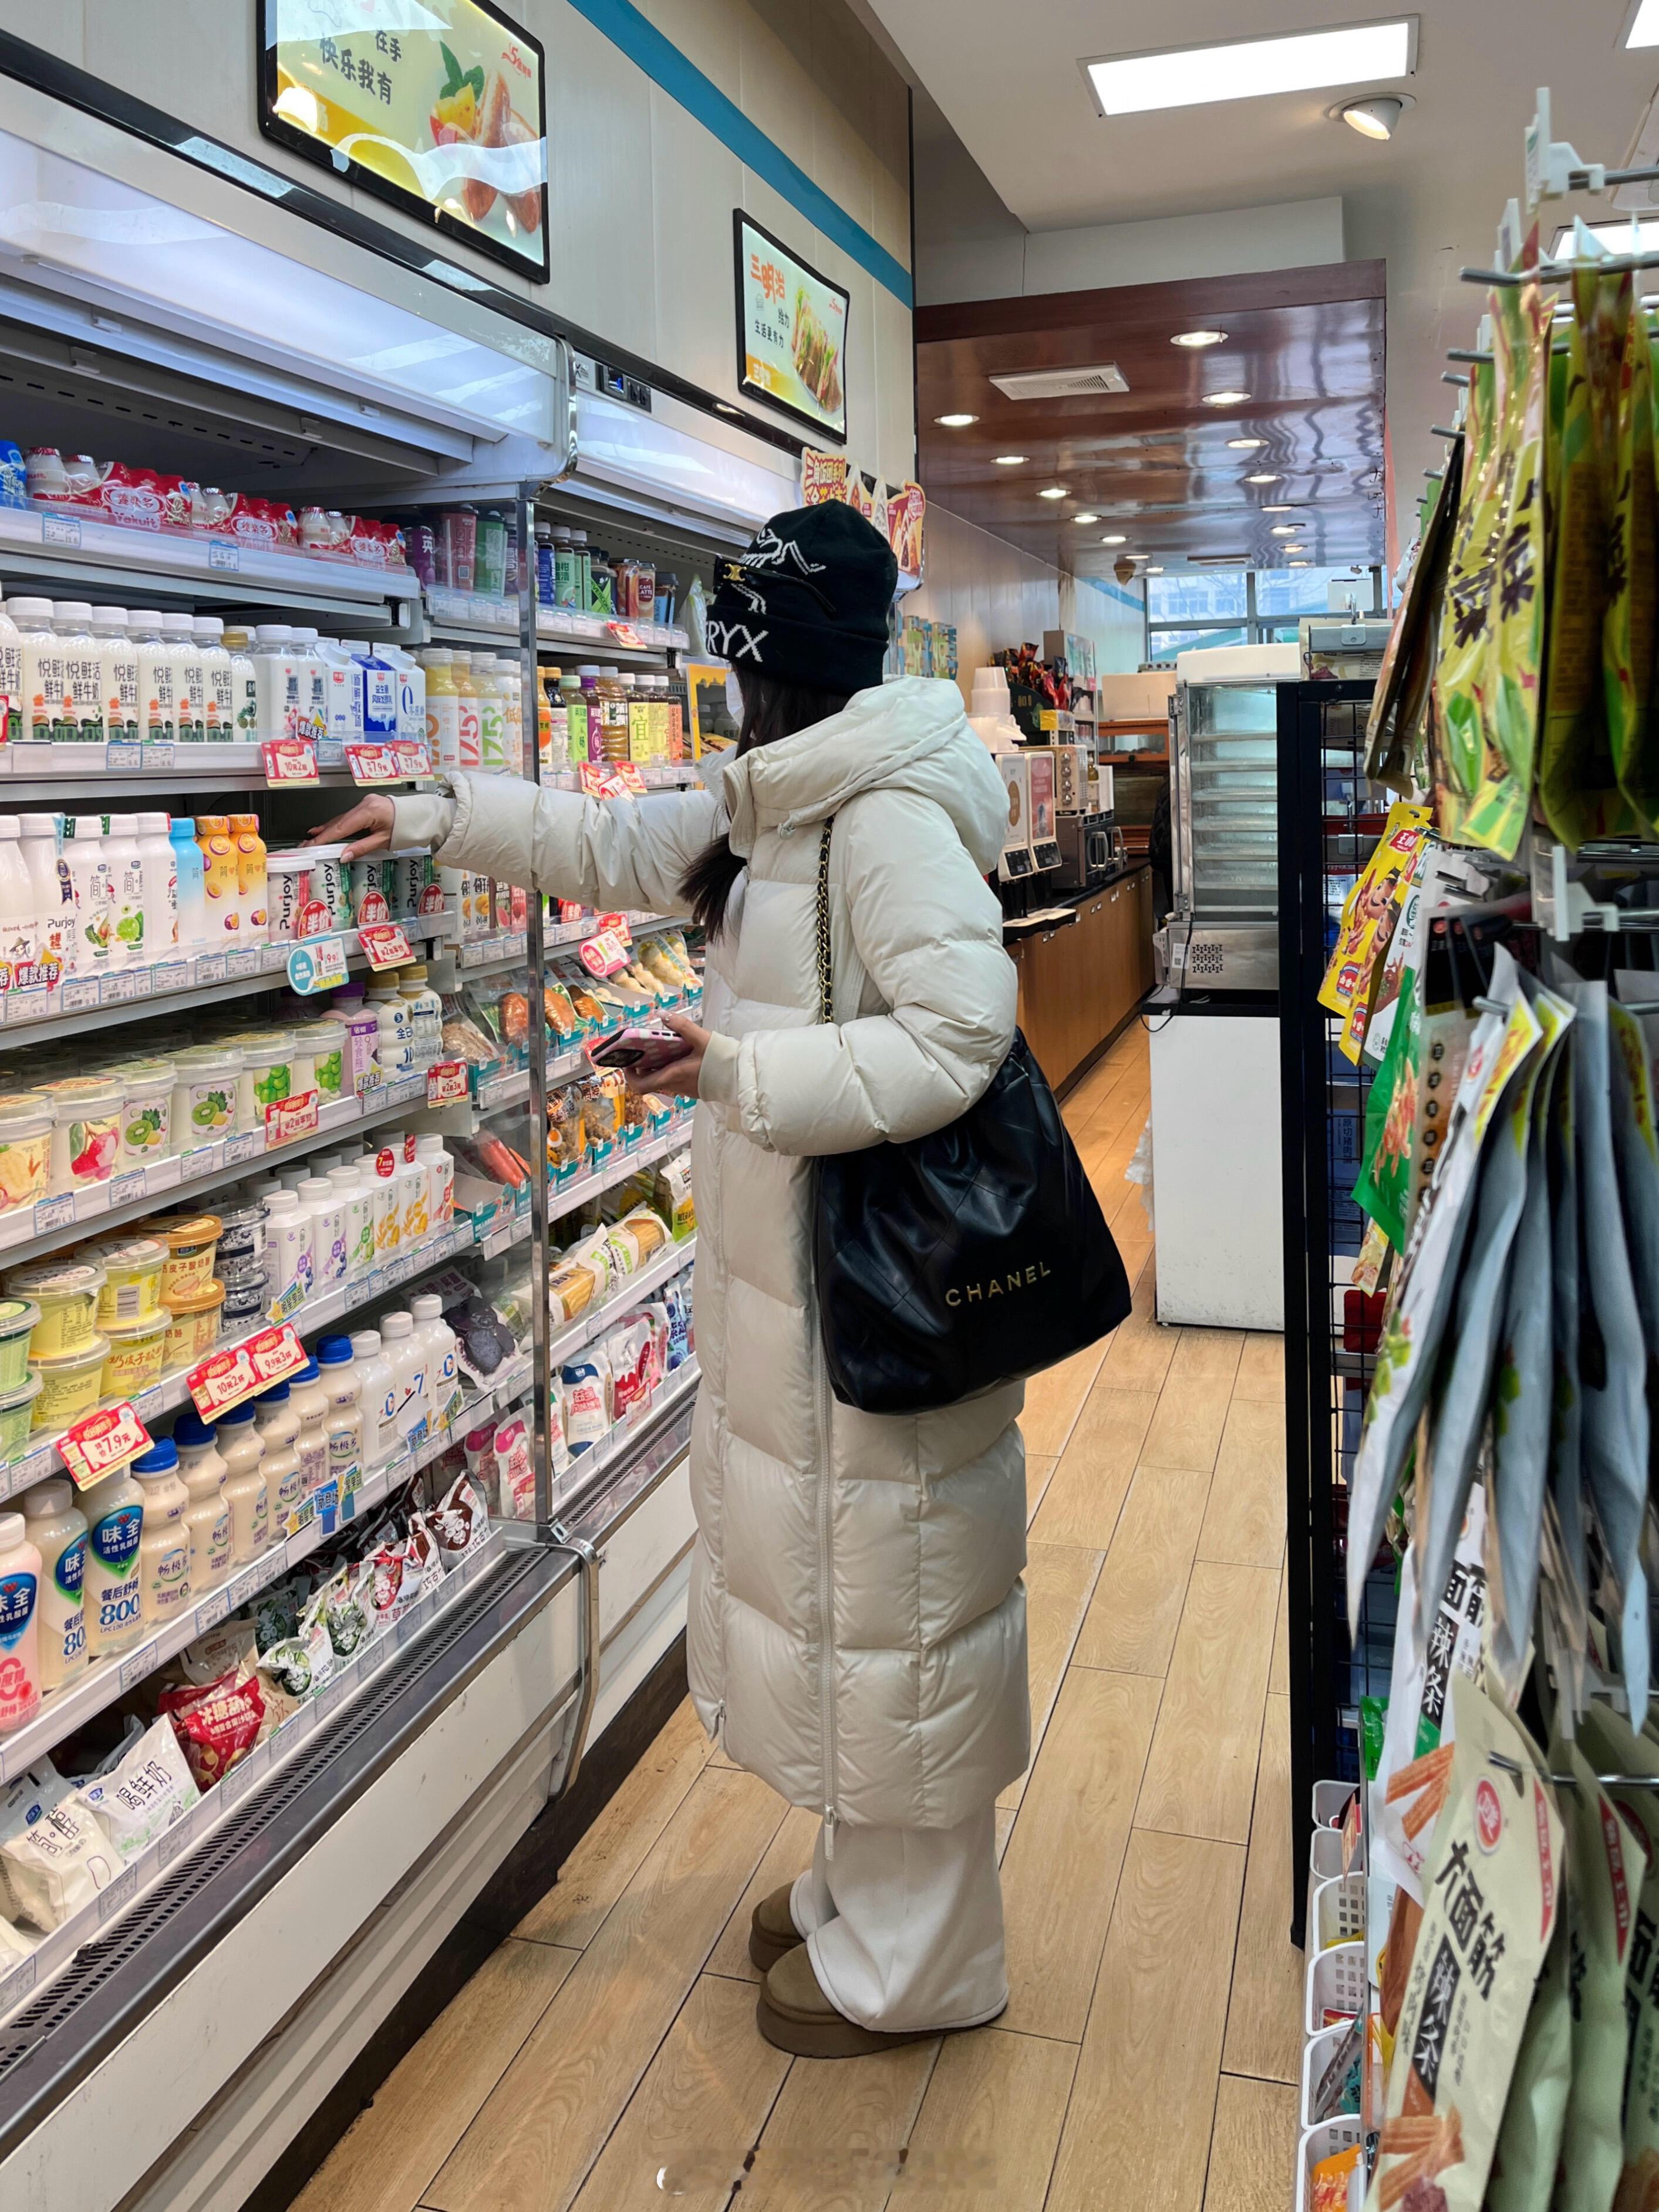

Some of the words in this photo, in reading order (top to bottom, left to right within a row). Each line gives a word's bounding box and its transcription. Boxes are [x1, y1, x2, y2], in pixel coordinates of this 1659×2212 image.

[375, 28, 403, 62] 在手
[319, 35, 394, 106] 快乐我有
[422, 535, 433, 554] 英
[705, 619, 768, 662] RYX
[72, 680, 100, 701] 鲜牛奶
[632, 715, 649, 741] 宜
[406, 859, 421, 908] Purjoy
[278, 874, 293, 930] Purjoy
[366, 902, 388, 921] 半价
[426, 892, 446, 912] 半价
[46, 916, 76, 929] Purjoy
[306, 913, 330, 933] 半价
[18, 962, 59, 987] 爆款推荐
[945, 1262, 1051, 1306] CHANEL
[216, 1373, 245, 1395] 10元2杯
[102, 1518, 140, 1544] 味全
[103, 1536, 139, 1555] 活性乳酸菌
[101, 1577, 139, 1602] 餐后舒畅
[99, 1593, 140, 1626] 800
[1421, 1616, 1455, 1716] 辣条
[1435, 1840, 1506, 2002] 大面筋
[1414, 1950, 1456, 2085] 辣条
